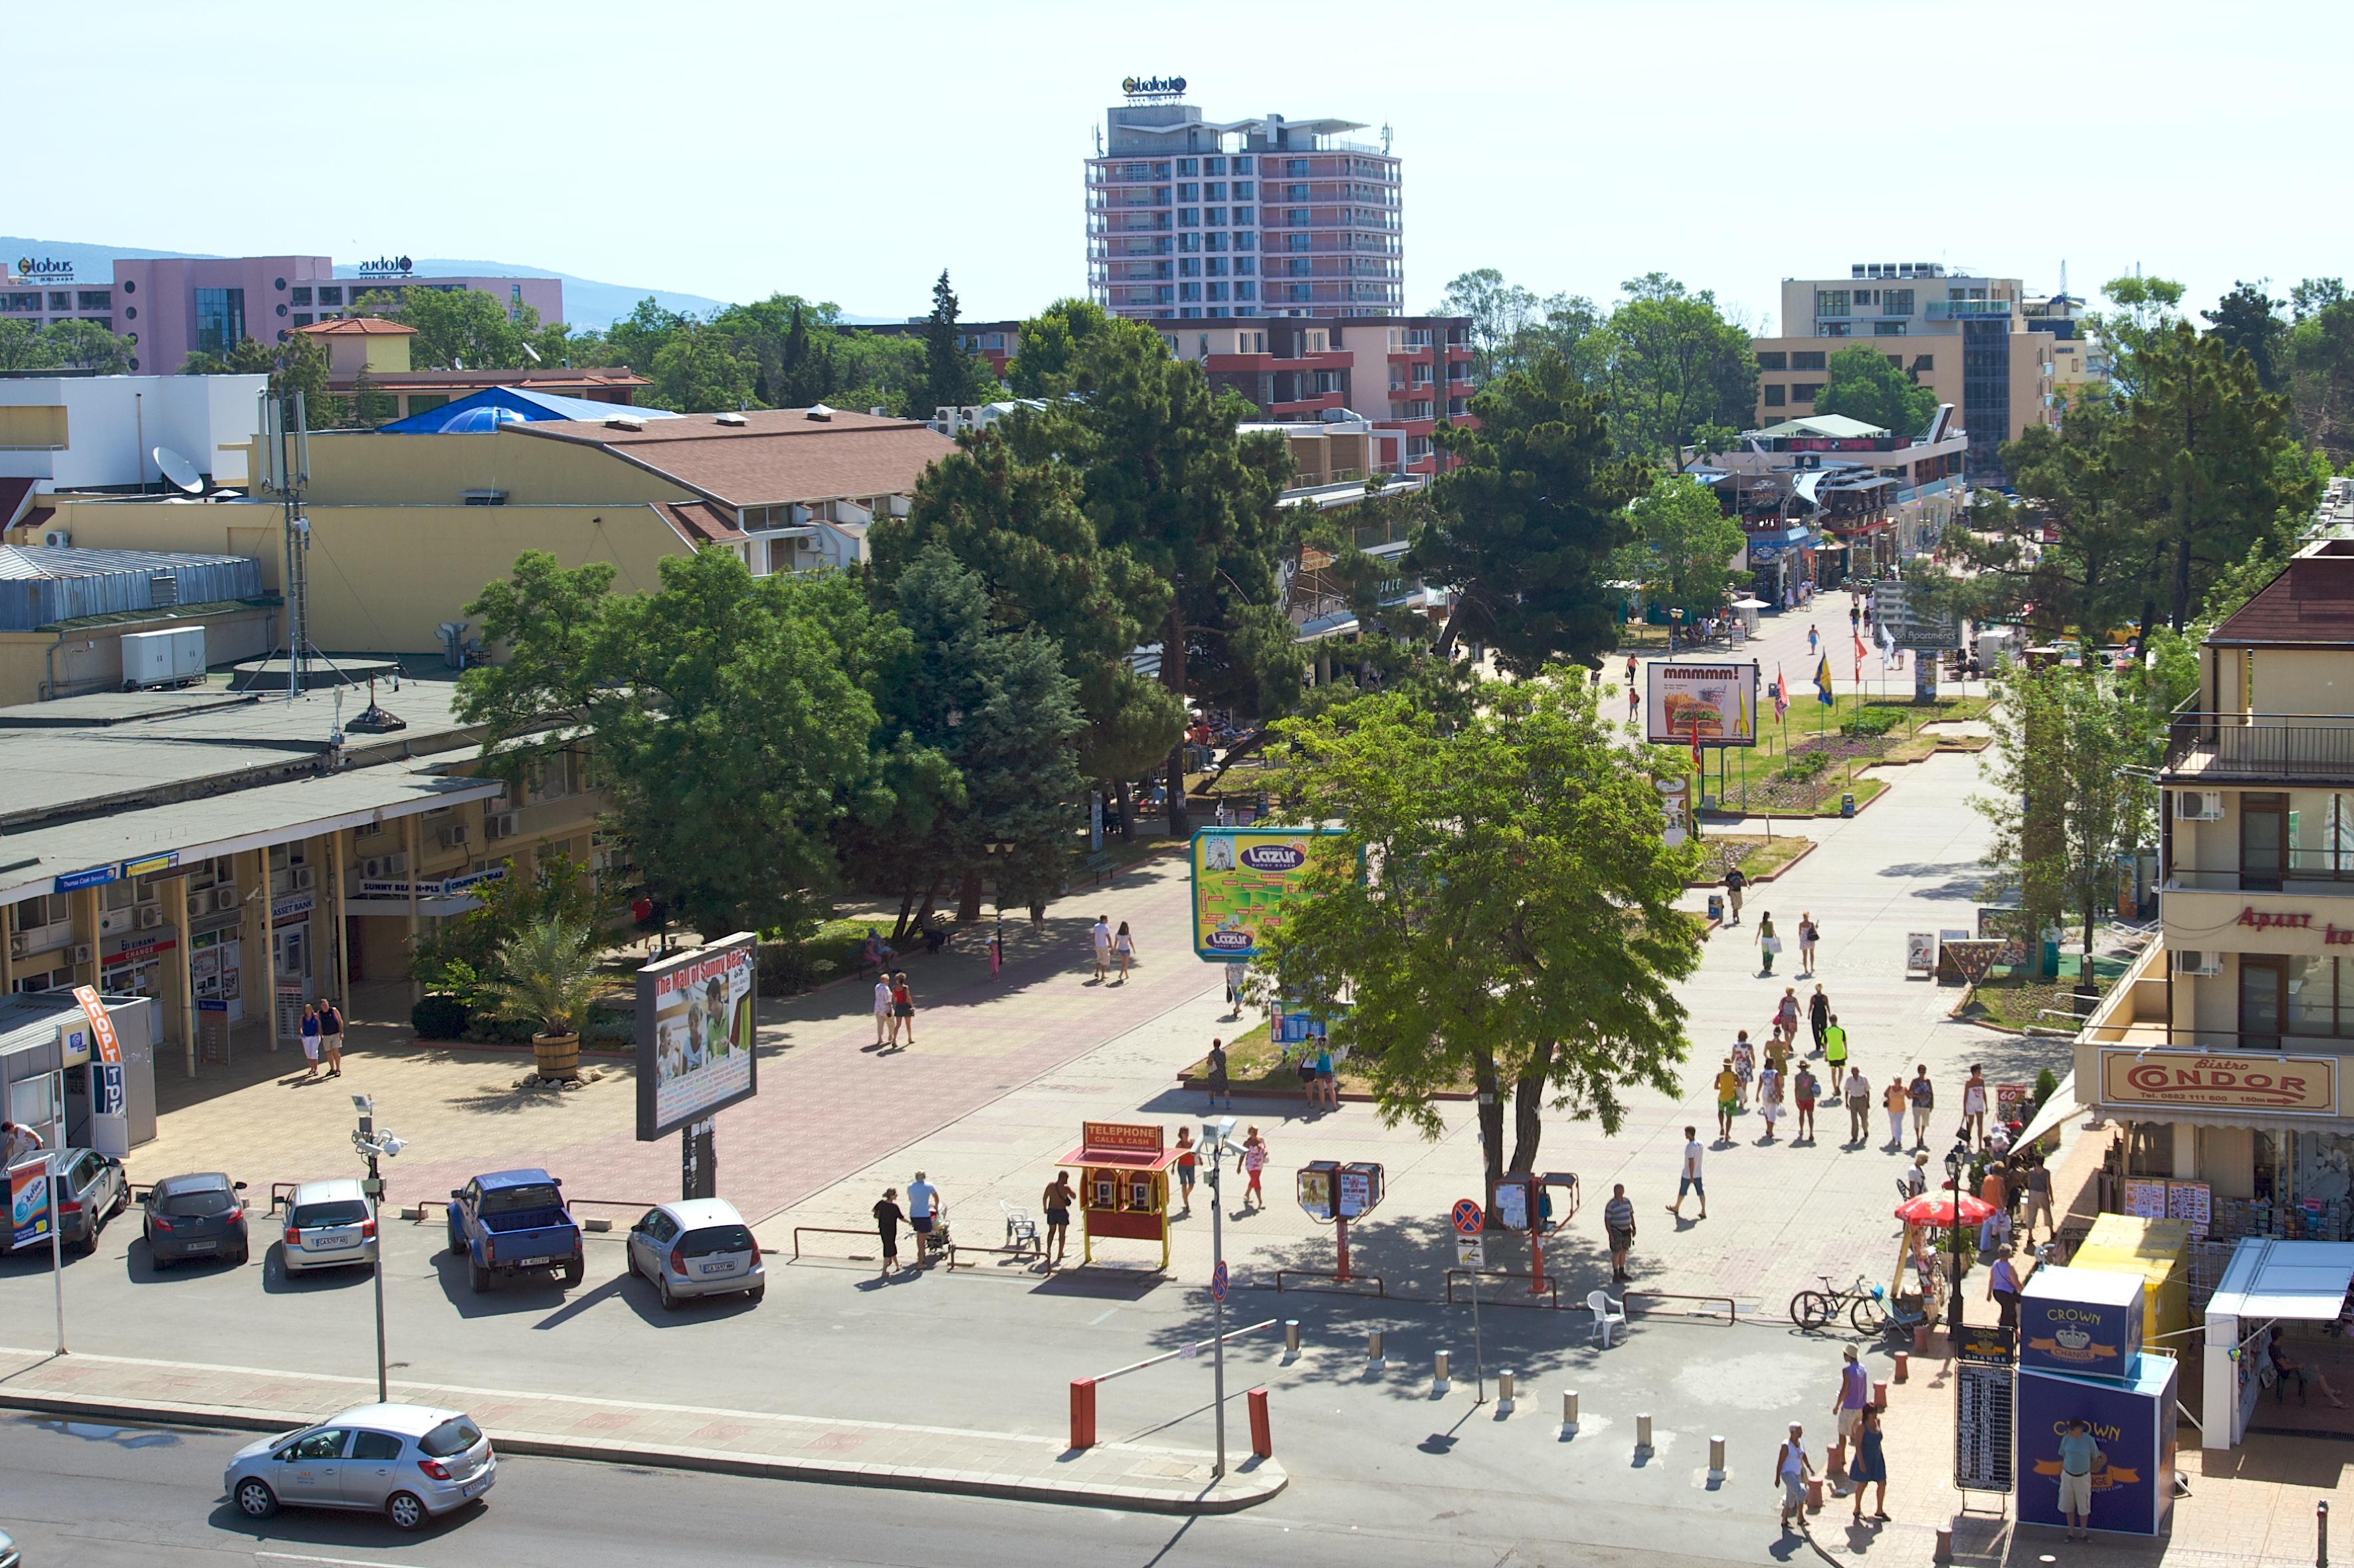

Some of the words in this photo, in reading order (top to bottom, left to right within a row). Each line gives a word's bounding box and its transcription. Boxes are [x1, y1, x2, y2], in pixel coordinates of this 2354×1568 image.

[1122, 76, 1187, 92] Globus
[18, 257, 73, 274] Globus
[1380, 579, 1401, 593] SALE
[1908, 631, 1956, 642] Apartments
[1664, 666, 1739, 680] mmmmm!
[1249, 847, 1296, 863] Lazur
[63, 878, 79, 888] Thomas
[80, 876, 90, 886] Cook
[272, 905, 293, 917] ASSET
[294, 900, 312, 912] BANK
[1212, 932, 1247, 945] Lazur
[125, 946, 154, 959] CHANGE
[656, 977, 670, 996] The
[672, 967, 690, 990] Mall
[692, 963, 700, 983] of
[701, 955, 725, 978] Sunny
[80, 989, 116, 1062] СПОРТ
[2193, 1058, 2249, 1071] Bistro
[2127, 1064, 2307, 1095] CONDOR
[2000, 1091, 2016, 1100] 60
[1088, 1126, 1155, 1138] TELEPHONE
[2047, 1308, 2102, 1325] CROWN
[1965, 1353, 2007, 1363] CHANGE
[2054, 1349, 2090, 1360] CHANGE
